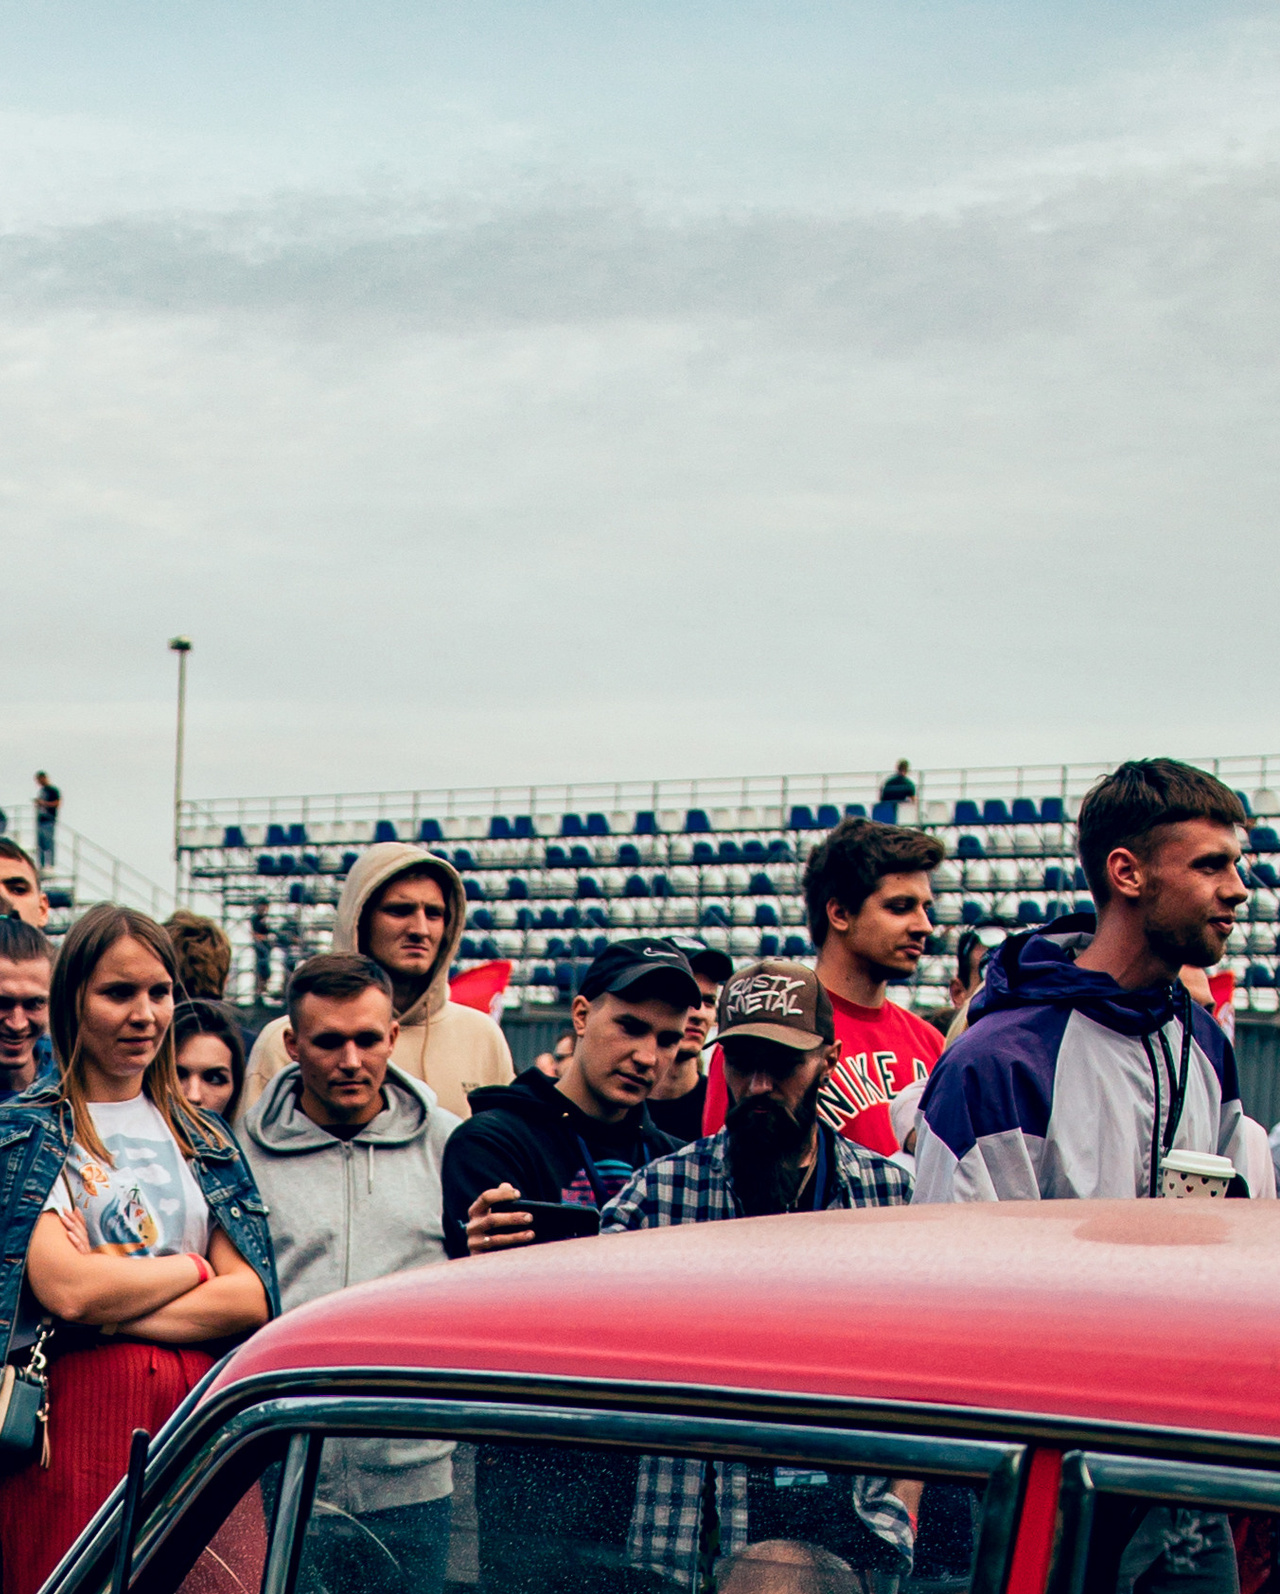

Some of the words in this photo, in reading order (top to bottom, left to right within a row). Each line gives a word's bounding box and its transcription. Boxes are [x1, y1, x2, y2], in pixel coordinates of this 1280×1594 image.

[728, 974, 806, 1003] RUSTY
[726, 990, 803, 1021] METAL
[816, 1050, 899, 1132] NIKE
